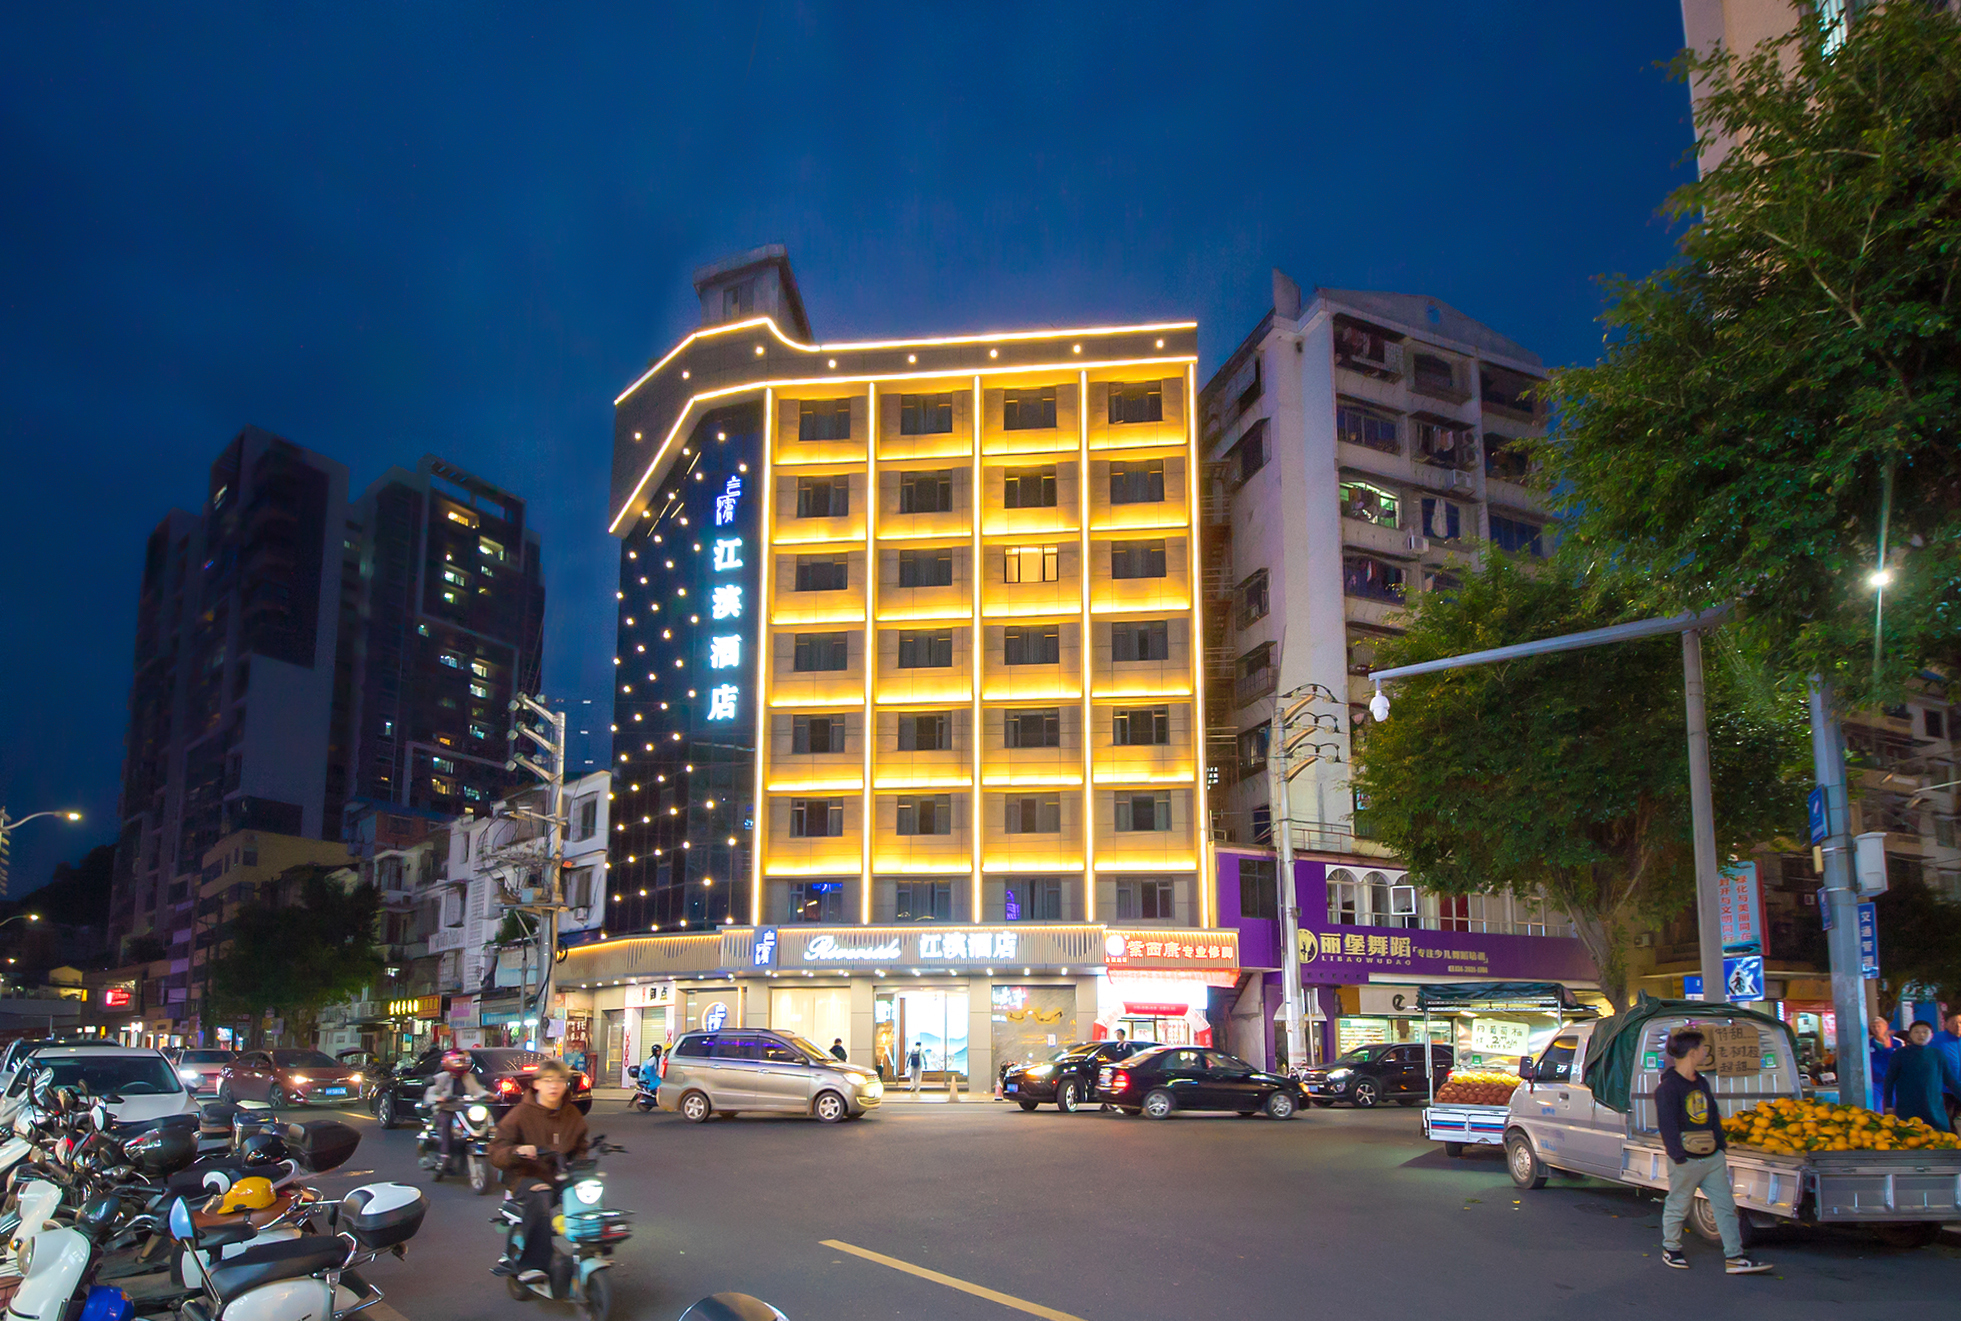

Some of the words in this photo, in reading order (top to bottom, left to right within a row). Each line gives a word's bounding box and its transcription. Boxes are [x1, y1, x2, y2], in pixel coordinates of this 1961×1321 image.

[1320, 932, 1411, 958] 丽堡舞蹈
[1322, 955, 1411, 966] LIBAOWUDAO
